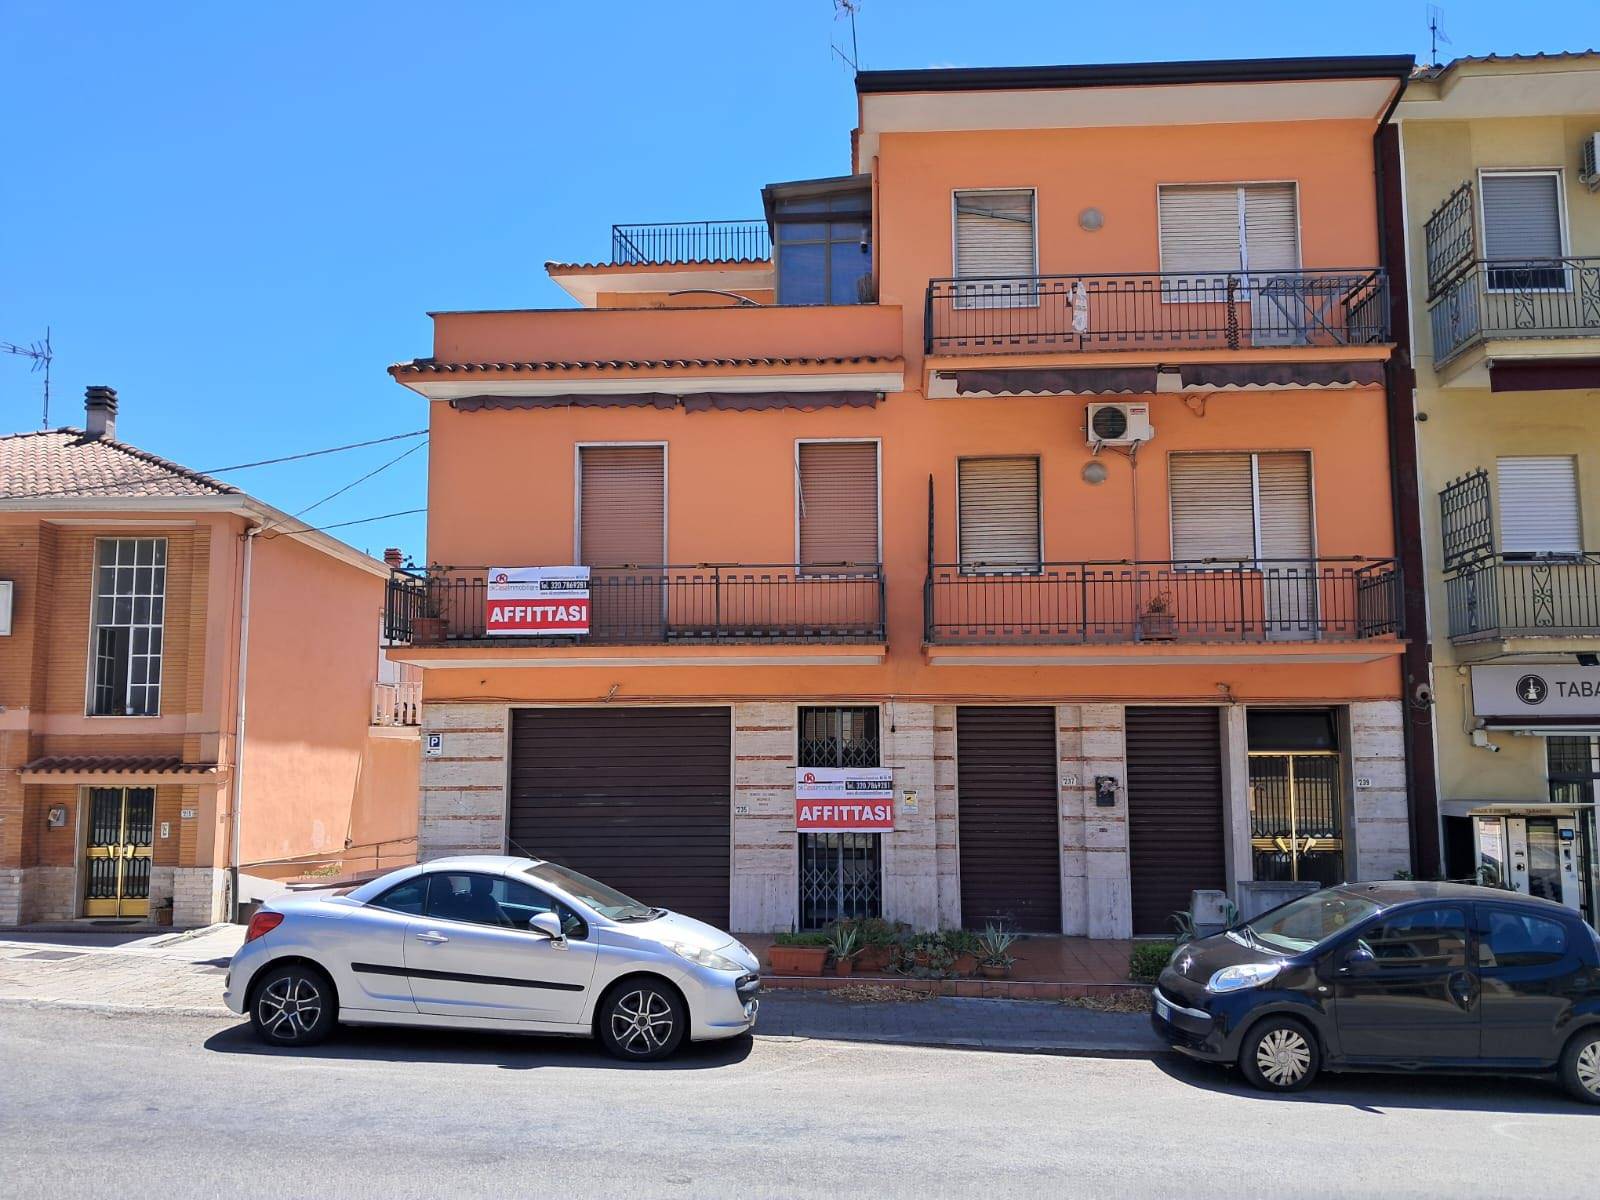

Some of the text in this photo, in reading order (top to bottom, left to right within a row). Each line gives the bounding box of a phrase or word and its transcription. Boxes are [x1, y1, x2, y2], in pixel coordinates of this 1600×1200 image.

[490, 605, 587, 623] AFFITTASI
[431, 737, 438, 747] P
[799, 805, 891, 821] AFFITTASI
